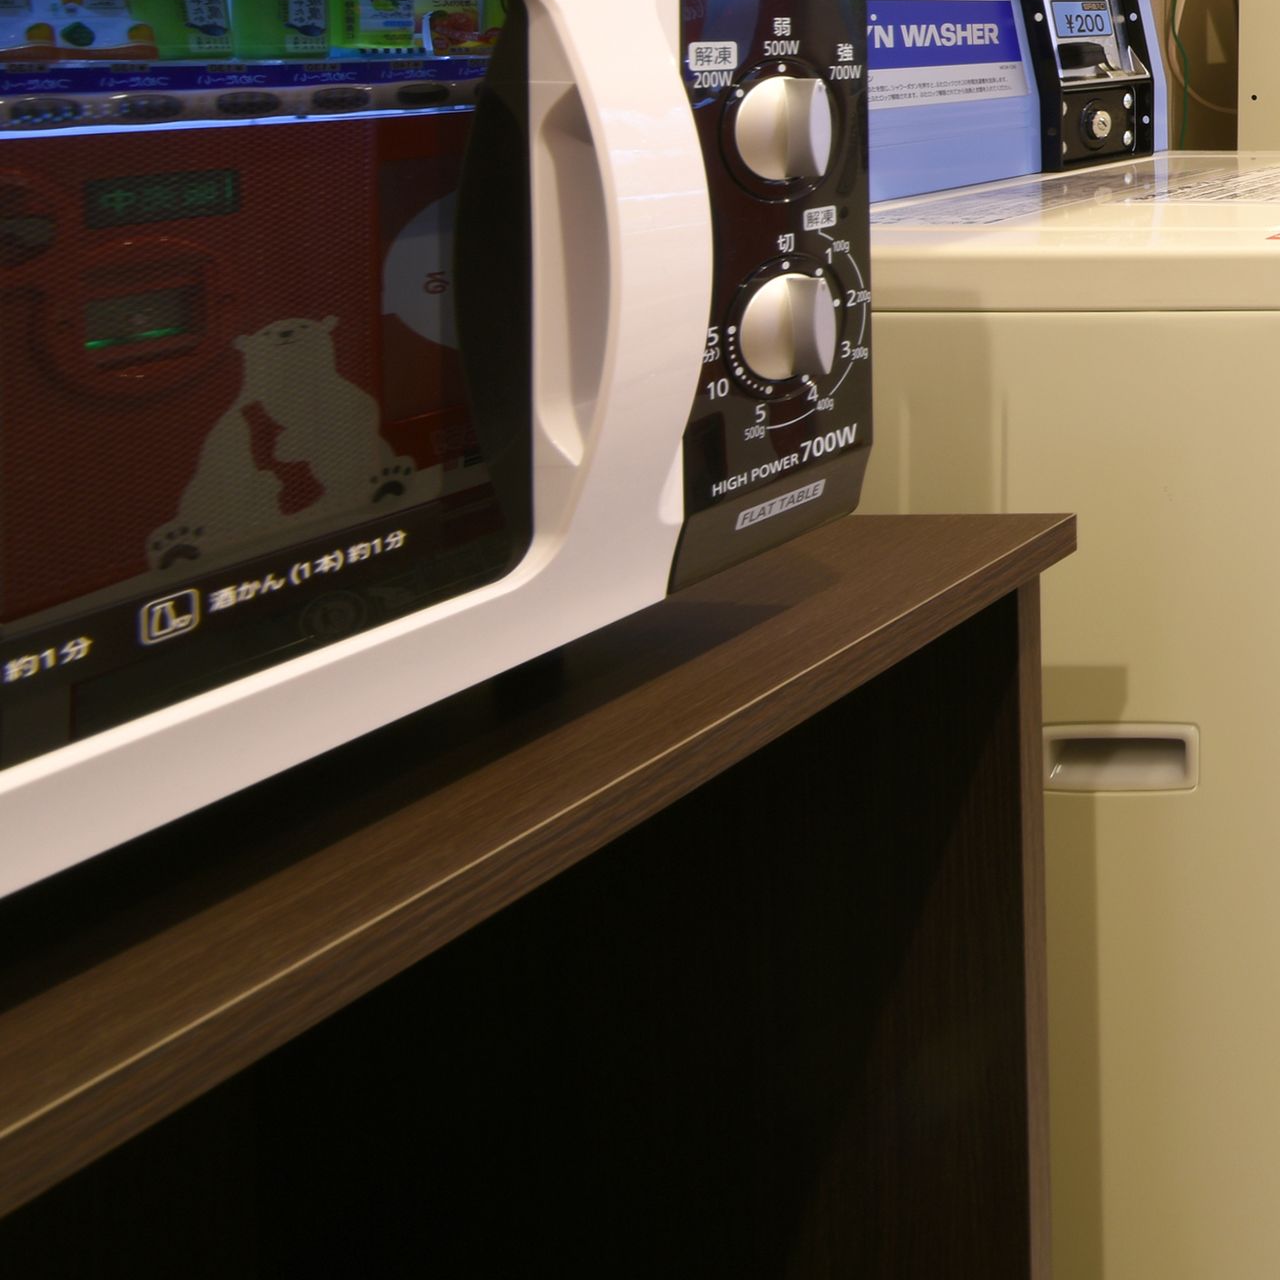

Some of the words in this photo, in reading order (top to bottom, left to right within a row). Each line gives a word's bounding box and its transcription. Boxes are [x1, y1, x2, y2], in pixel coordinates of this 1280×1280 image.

[773, 17, 791, 37] 弱
[1065, 12, 1105, 35] ¥200
[901, 23, 1000, 49] WASHER
[694, 46, 733, 67] 解凍
[763, 40, 800, 57] 500W
[836, 43, 854, 63] 強
[693, 71, 734, 89] 200W
[828, 64, 862, 81] 700W
[806, 208, 834, 230] 解凍
[777, 233, 795, 253] 切
[832, 239, 850, 254] 100g
[846, 289, 857, 308] 2
[856, 290, 871, 304] 200g
[708, 325, 720, 348] 5
[840, 340, 851, 358] 3
[851, 346, 869, 361] 300g
[706, 378, 730, 401] 10
[806, 385, 819, 403] 4
[816, 396, 835, 412] 400g
[755, 403, 767, 423] 5
[743, 425, 766, 441] 500g
[711, 472, 748, 497] HIGH
[751, 452, 800, 482] POWER
[800, 423, 858, 464] 700W
[741, 498, 776, 526] FLAT
[777, 483, 822, 511] TABLE
[2, 635, 95, 685] 約1分
